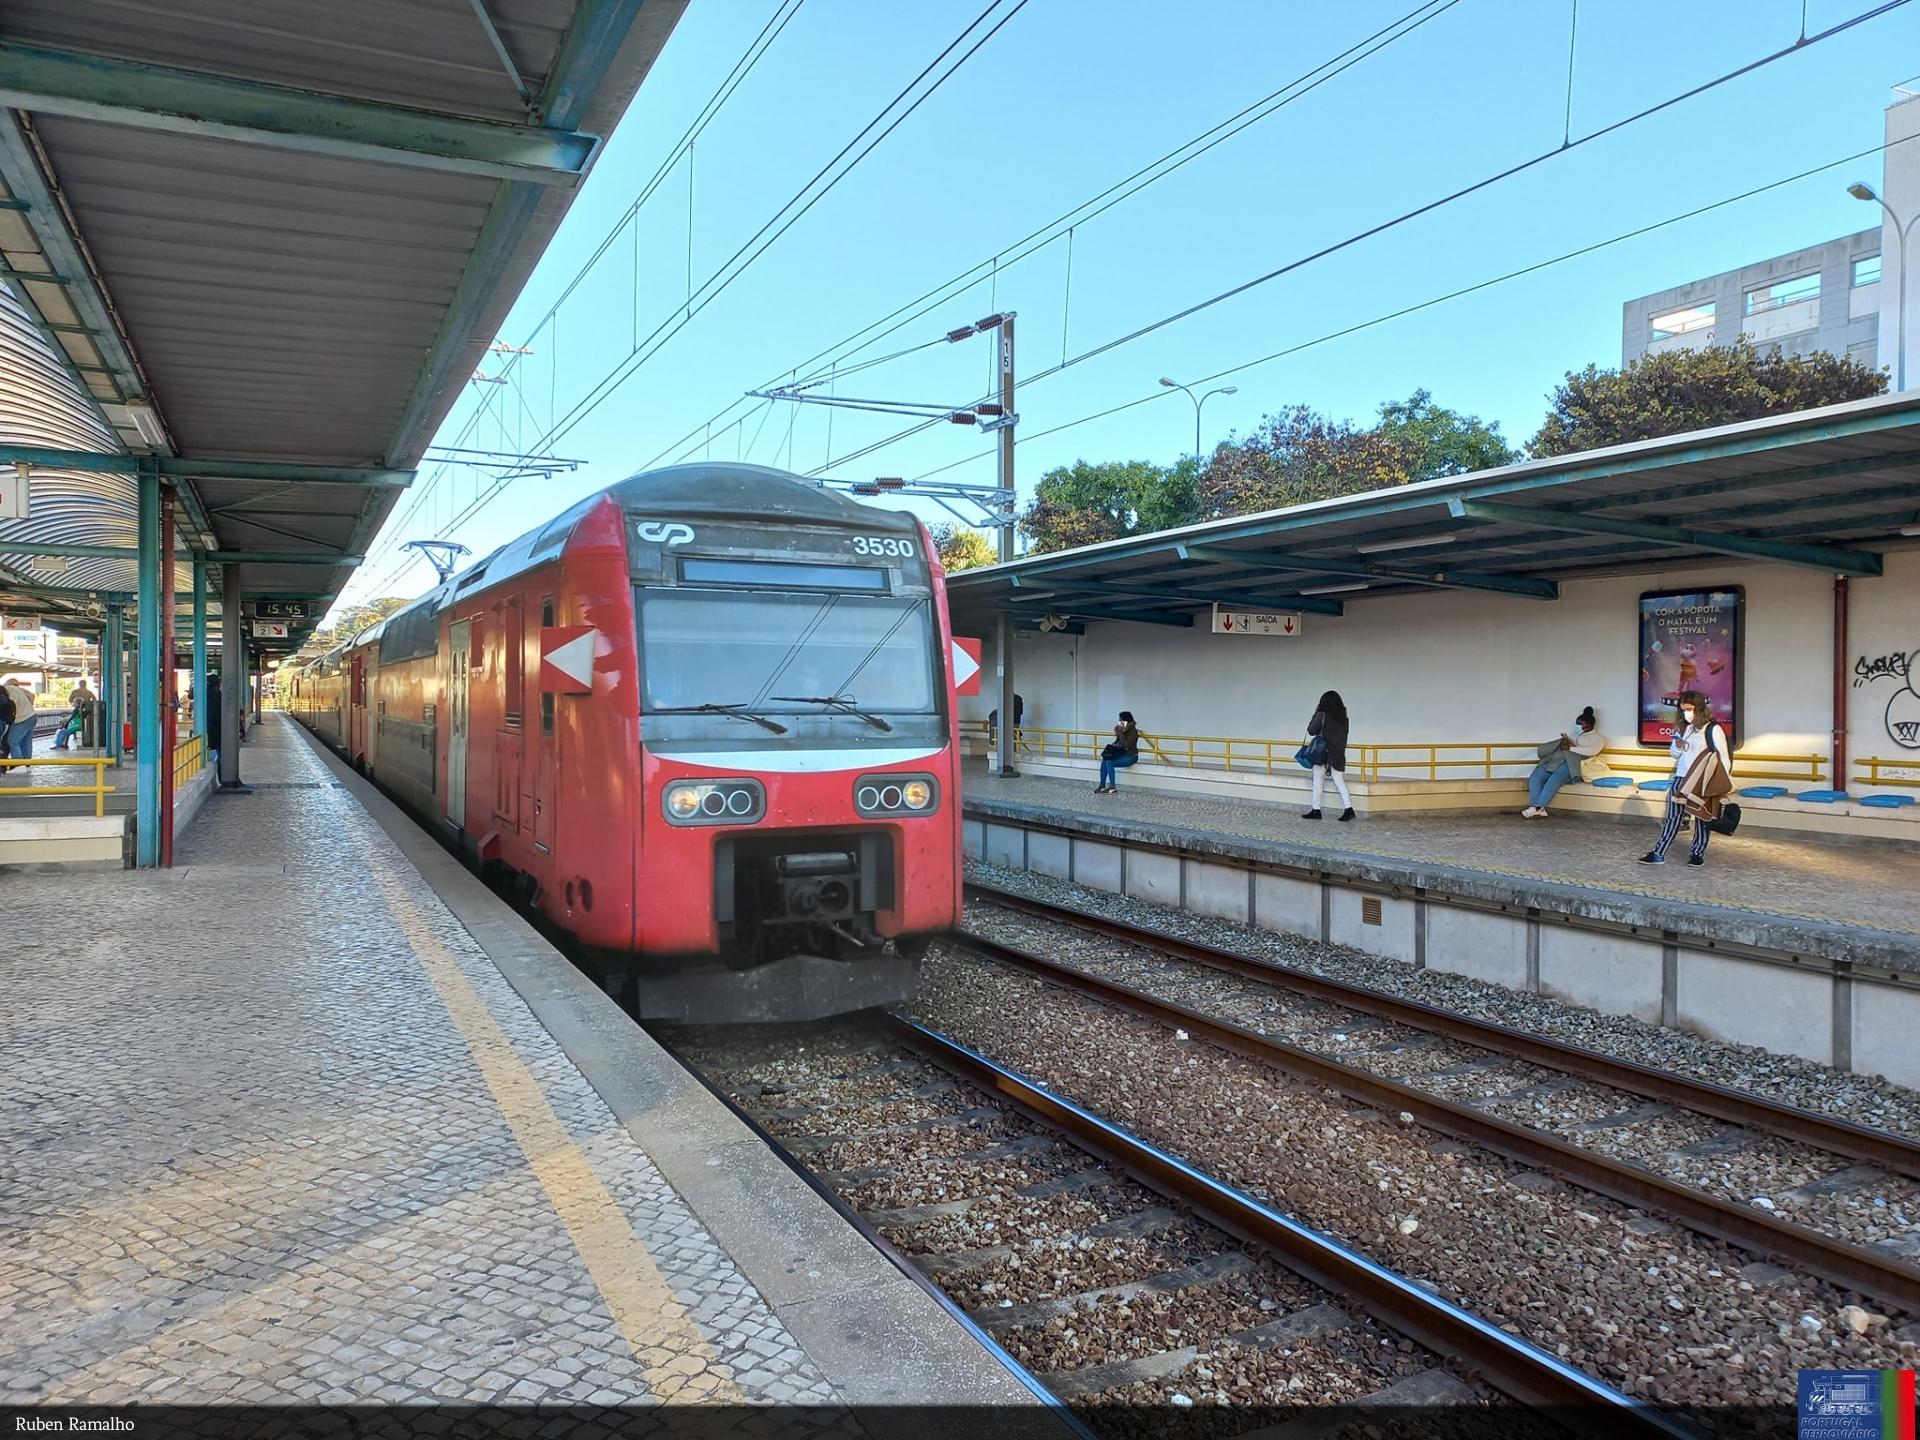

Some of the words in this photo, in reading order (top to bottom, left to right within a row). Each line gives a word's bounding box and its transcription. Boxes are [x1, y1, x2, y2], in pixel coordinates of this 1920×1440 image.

[637, 522, 695, 545] CP
[852, 536, 914, 557] 3530
[1655, 608, 1675, 616] COM
[1667, 617, 1693, 625] NATAL
[1703, 616, 1717, 624] UM
[1669, 626, 1707, 635] FESTIVAL
